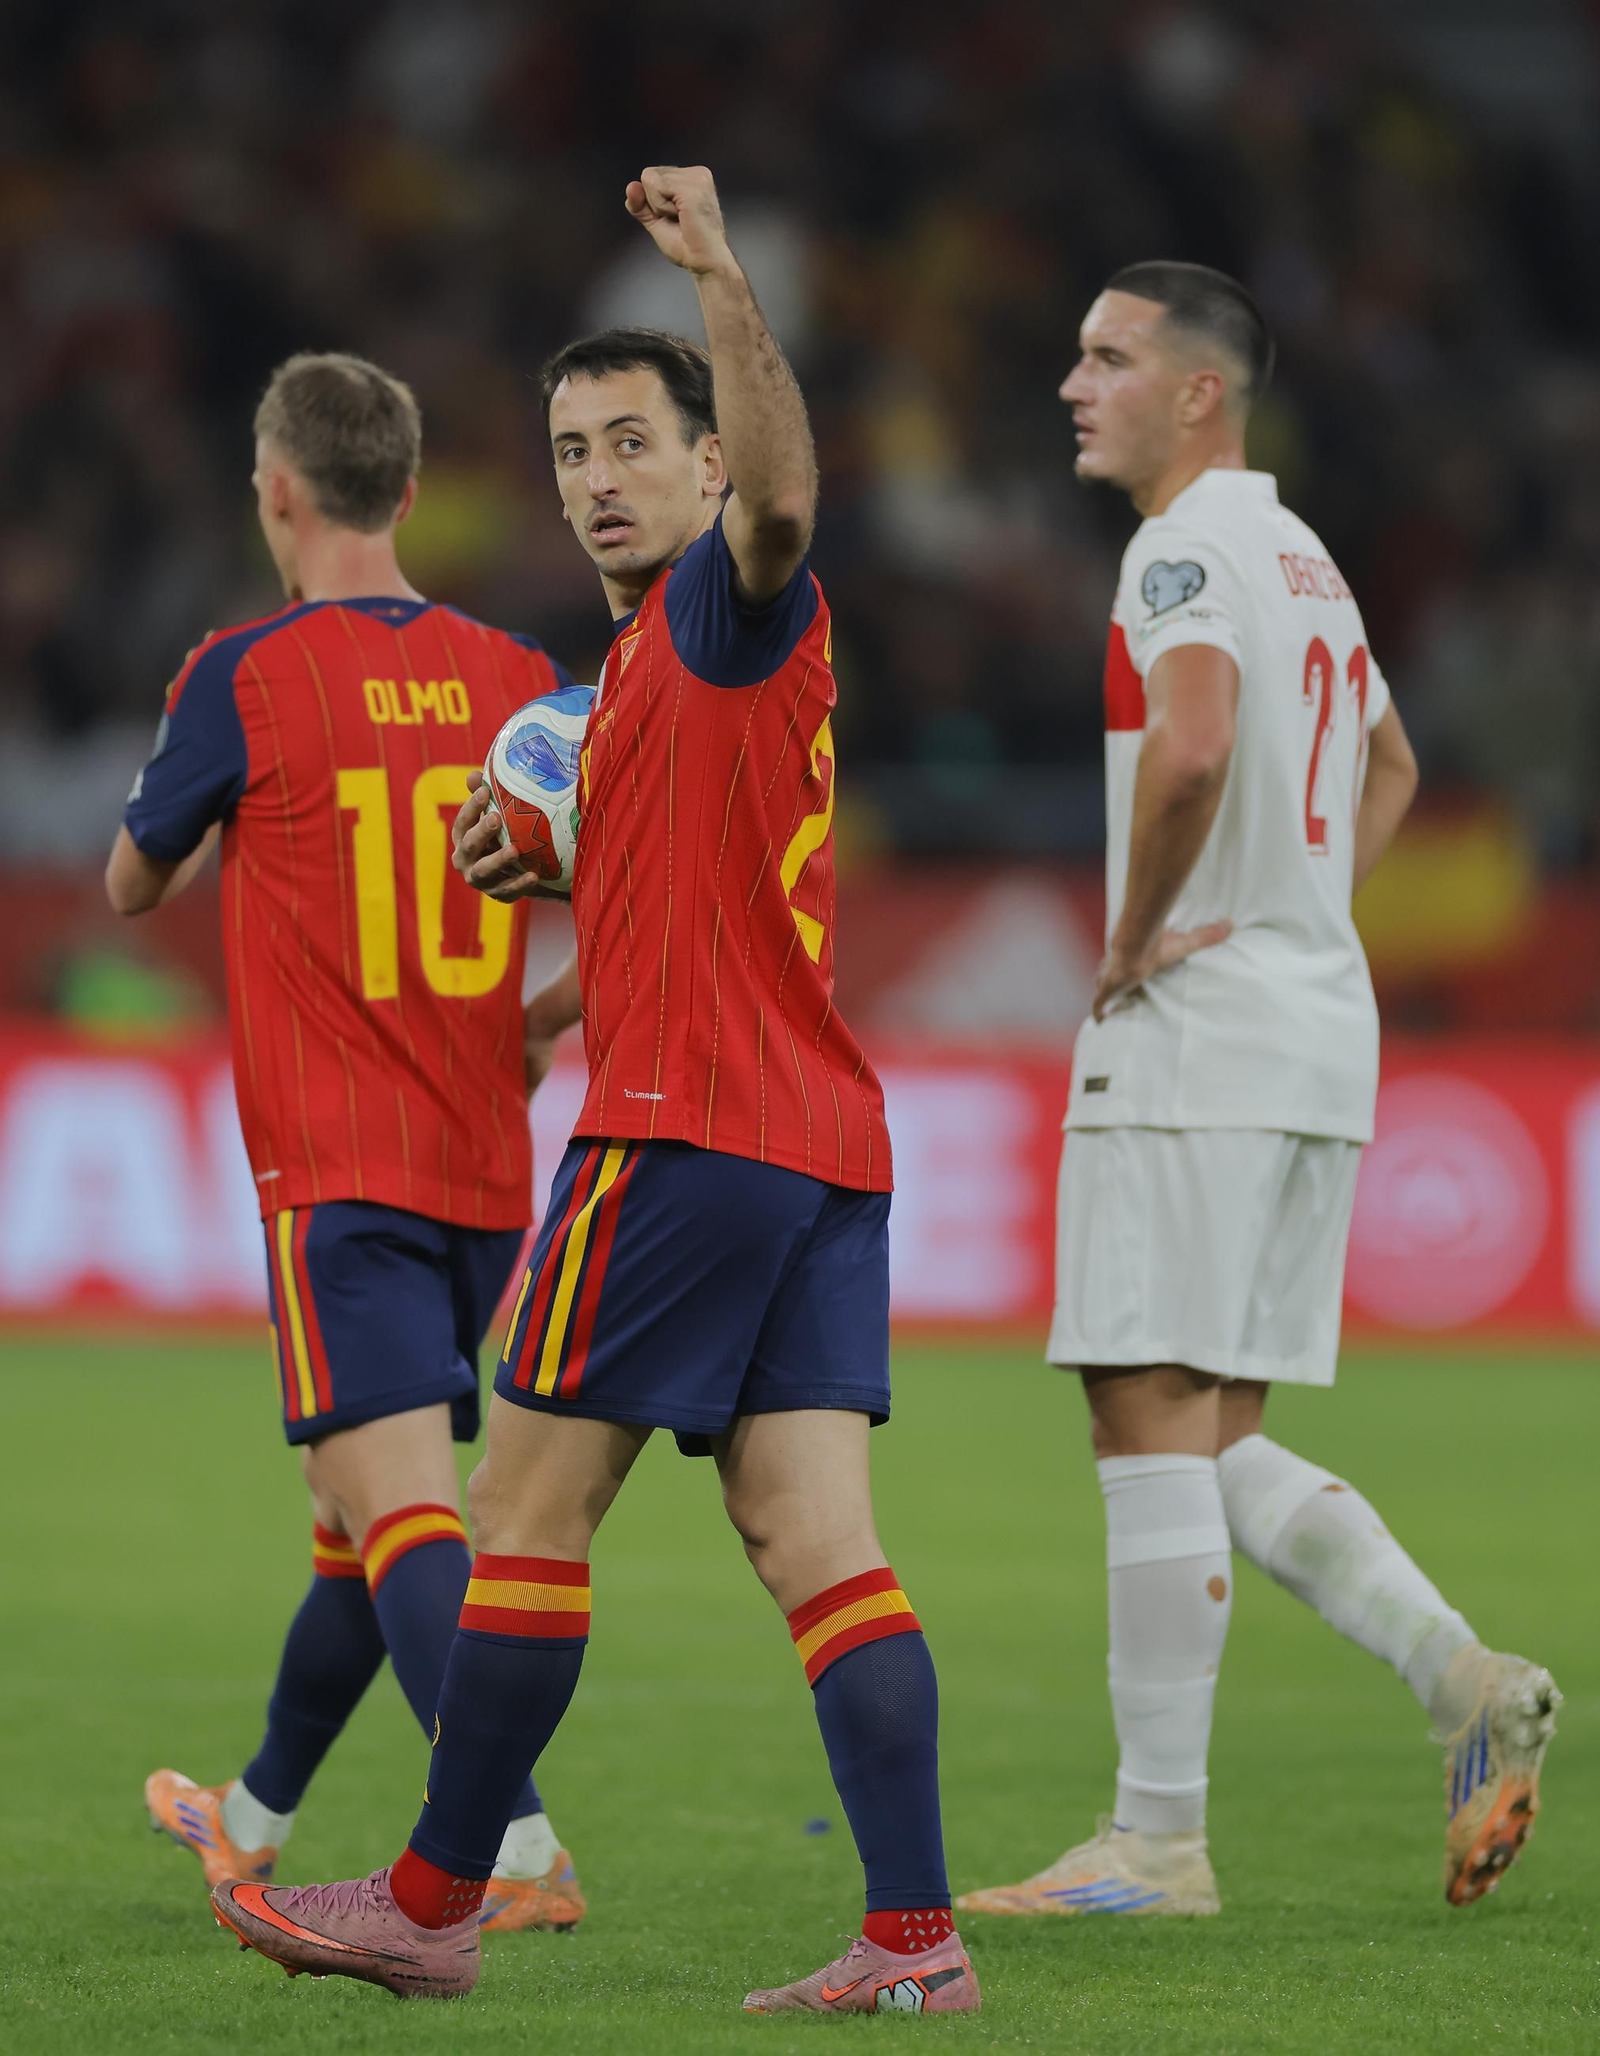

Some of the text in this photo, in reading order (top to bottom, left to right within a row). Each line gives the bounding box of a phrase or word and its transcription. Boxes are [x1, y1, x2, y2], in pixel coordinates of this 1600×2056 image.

[363, 678, 471, 725] OLMO
[1303, 636, 1370, 855] 21
[336, 765, 514, 1000] 10
